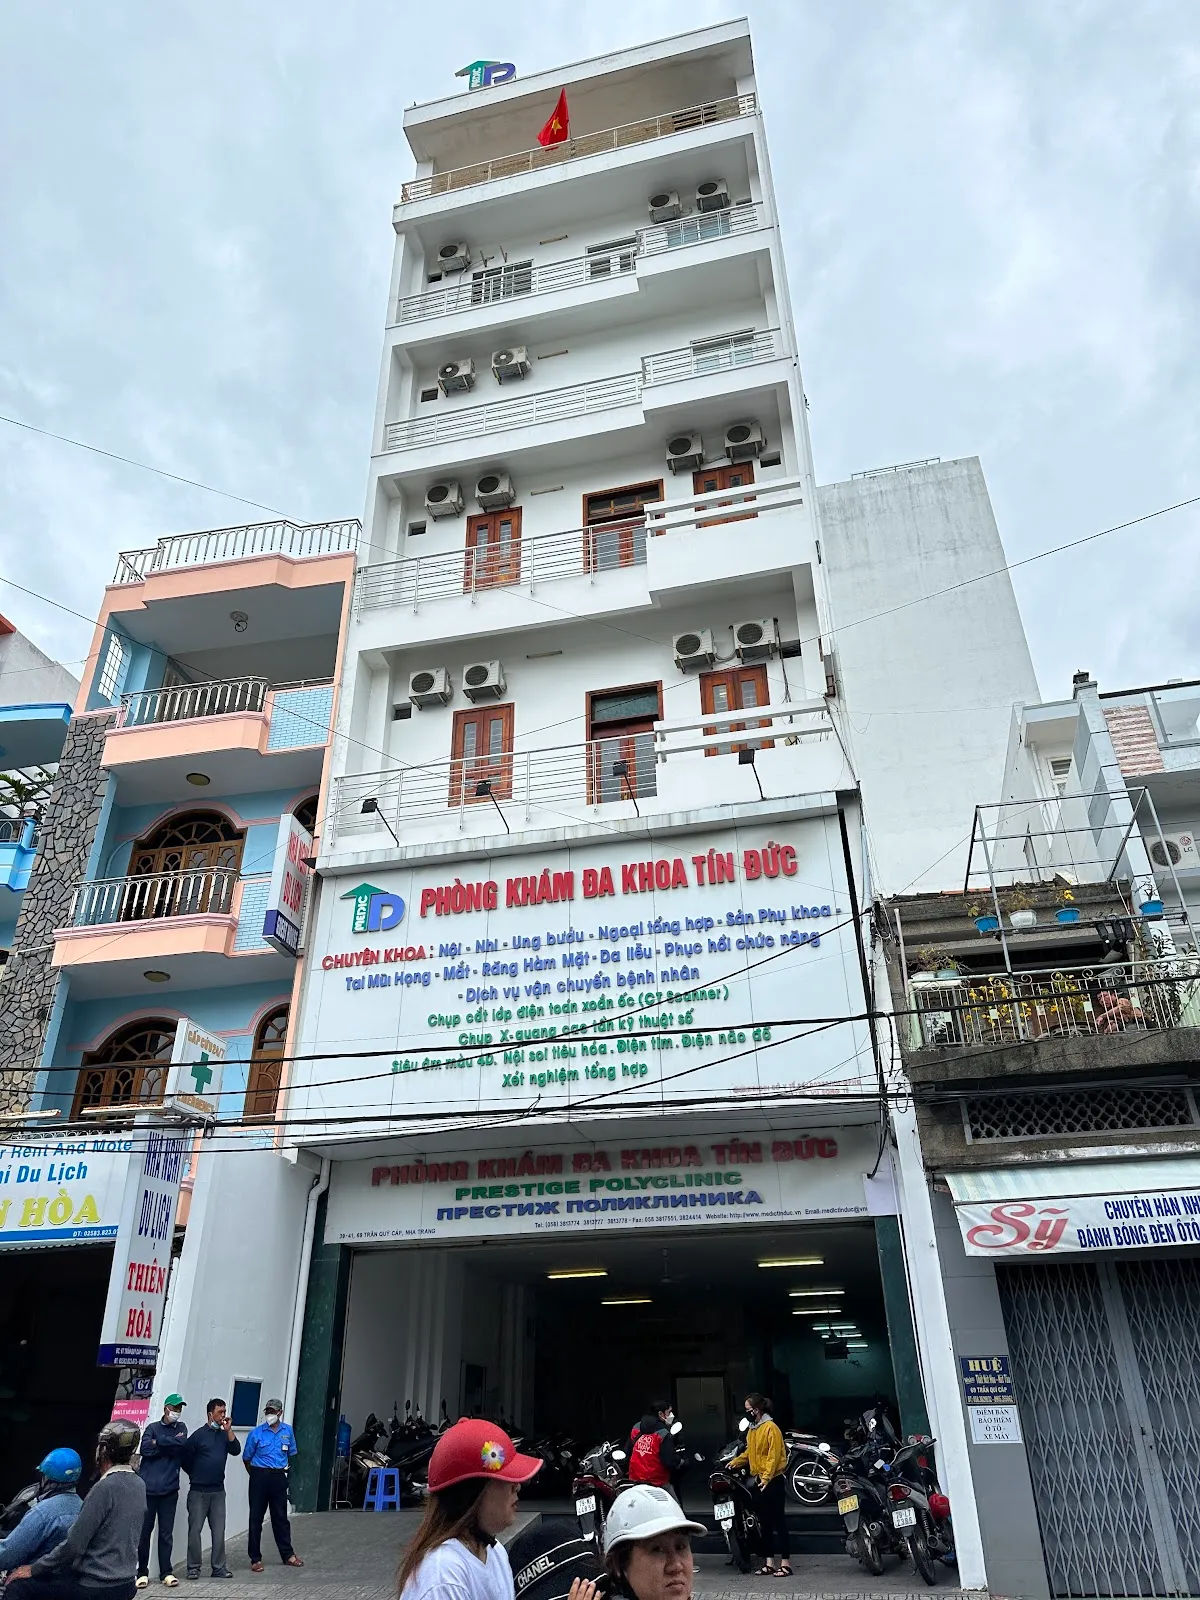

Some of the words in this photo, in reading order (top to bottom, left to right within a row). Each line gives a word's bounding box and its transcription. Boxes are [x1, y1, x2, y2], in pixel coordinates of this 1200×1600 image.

[420, 878, 498, 917] PHÒNG
[506, 868, 574, 908] KHÁM
[582, 866, 615, 898] ĐA
[621, 858, 688, 894] KHOA
[692, 848, 735, 886] TÍN
[744, 840, 799, 880] ĐỨC
[355, 895, 368, 931] MEDIC
[321, 947, 379, 971] CHUYÊN
[438, 942, 462, 960] Nội
[475, 939, 498, 954] Nhi
[512, 934, 541, 951] Ung
[546, 926, 584, 944] bướu
[598, 920, 644, 943] Ngoại
[647, 914, 680, 936] tổng
[685, 915, 714, 934] hợp
[725, 908, 754, 928] Sản
[758, 907, 786, 926] Phụ
[791, 903, 831, 921] khoa
[345, 974, 366, 992] Tai
[367, 972, 392, 990] Mũi
[394, 970, 431, 990] Họng
[443, 960, 470, 981] Mắt
[482, 959, 519, 978] Răng
[523, 953, 557, 973] Hàm
[562, 950, 590, 969] Mặt
[600, 949, 621, 965] Da
[627, 942, 652, 961] liễu
[664, 939, 703, 959] Phục
[707, 934, 731, 954] hồi
[735, 931, 775, 950] chức
[779, 929, 821, 948] năng
[466, 986, 498, 1004] Dịch
[503, 986, 520, 1001] vụ
[524, 981, 551, 1001] vận
[556, 970, 611, 994] chuyển
[616, 968, 655, 990] bệnh
[661, 964, 700, 983] nhân
[427, 1012, 461, 1029] Chụp
[466, 1006, 488, 1024] cắt
[492, 1006, 512, 1023] lớp
[516, 1002, 544, 1020] điện
[549, 998, 578, 1016] toán
[581, 993, 614, 1012] xoắn
[618, 991, 635, 1008] ốc
[666, 984, 729, 1005] Scanner)
[499, 1026, 557, 1043] X-quang
[561, 1022, 587, 1037] cao
[593, 1013, 615, 1032] tần
[618, 1016, 634, 1032] kỹ
[638, 1013, 674, 1030] thuật
[677, 1008, 694, 1026] số
[391, 1058, 418, 1074] Siêu
[422, 1055, 442, 1072] âm
[445, 1053, 473, 1071] màu
[503, 1051, 525, 1067] Nội
[528, 1048, 548, 1062] soi
[552, 1044, 577, 1060] tiêu
[616, 1039, 647, 1055] Điện
[681, 1033, 713, 1050] Điện
[718, 1029, 746, 1045] não
[752, 1026, 772, 1042] đồ
[502, 1069, 525, 1088] Xét
[529, 1065, 579, 1087] nghiệm
[585, 1061, 616, 1081] tổng
[621, 1061, 648, 1077] hợp
[11, 1143, 49, 1159] Rent
[53, 1140, 86, 1156] And
[371, 1159, 469, 1187] PHÒNG
[477, 1151, 563, 1179] KHÁM
[573, 1150, 612, 1173] ĐA
[621, 1145, 704, 1170] KHOA
[711, 1138, 763, 1165] TÍN
[771, 1135, 839, 1163] ĐỨC
[16, 1165, 41, 1183] Du
[47, 1161, 88, 1185] Lịch
[455, 1179, 580, 1200] PRESTIGE
[589, 1171, 743, 1193] POLYCLINIC
[19, 1187, 101, 1228] HÒA
[138, 1189, 154, 1237] DU
[436, 1199, 559, 1221] ПРЕСТИЖ
[566, 1190, 764, 1213] ПОЛИКЛИНИКА
[1104, 1195, 1154, 1220] CHUYÊN
[1153, 1193, 1182, 1217] HÀN
[417, 1227, 436, 1235] TRANG
[966, 1203, 1071, 1250] Sỹ
[1077, 1224, 1112, 1249] ĐÁNH
[1113, 1221, 1149, 1246] BÓNG
[1149, 1219, 1177, 1243] ĐÈN
[128, 1258, 167, 1295] THIÊN
[125, 1302, 153, 1340] HÒA
[967, 1357, 1003, 1373] HUỆ
[137, 1380, 151, 1391] 67
[994, 1432, 1010, 1440] MÁY
[517, 1555, 555, 1588] CHANEL
